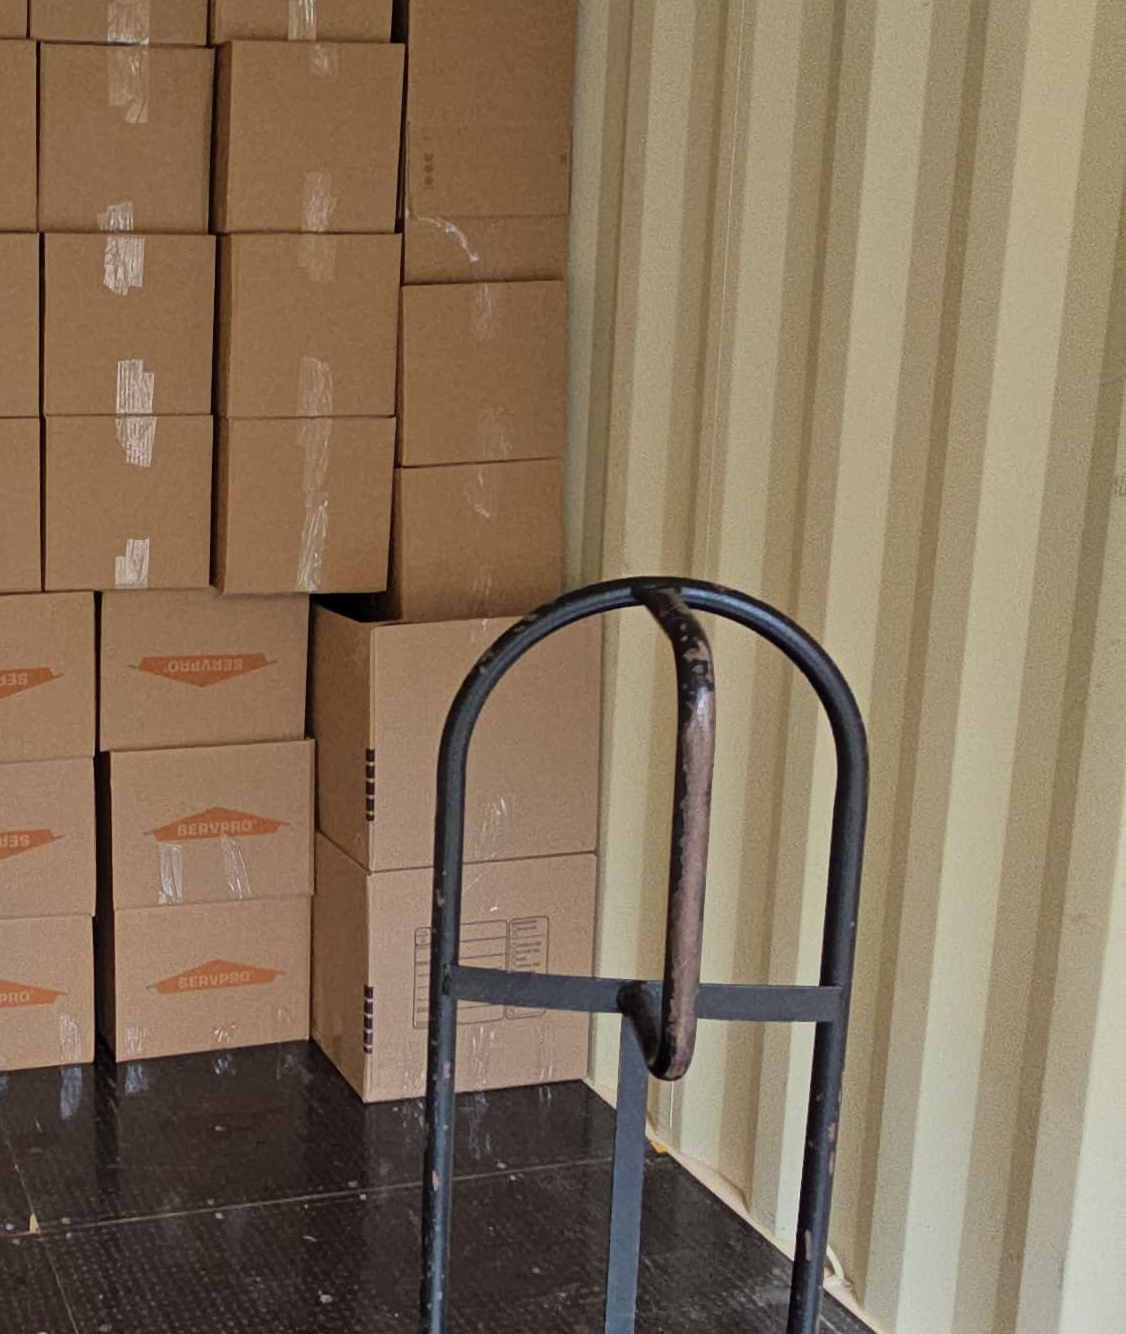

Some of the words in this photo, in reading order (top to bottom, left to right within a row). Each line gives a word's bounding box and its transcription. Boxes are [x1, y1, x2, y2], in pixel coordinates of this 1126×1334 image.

[167, 658, 243, 673] SERVPRO
[177, 820, 253, 836] SERVPRO
[178, 971, 251, 989] SERVPRO
